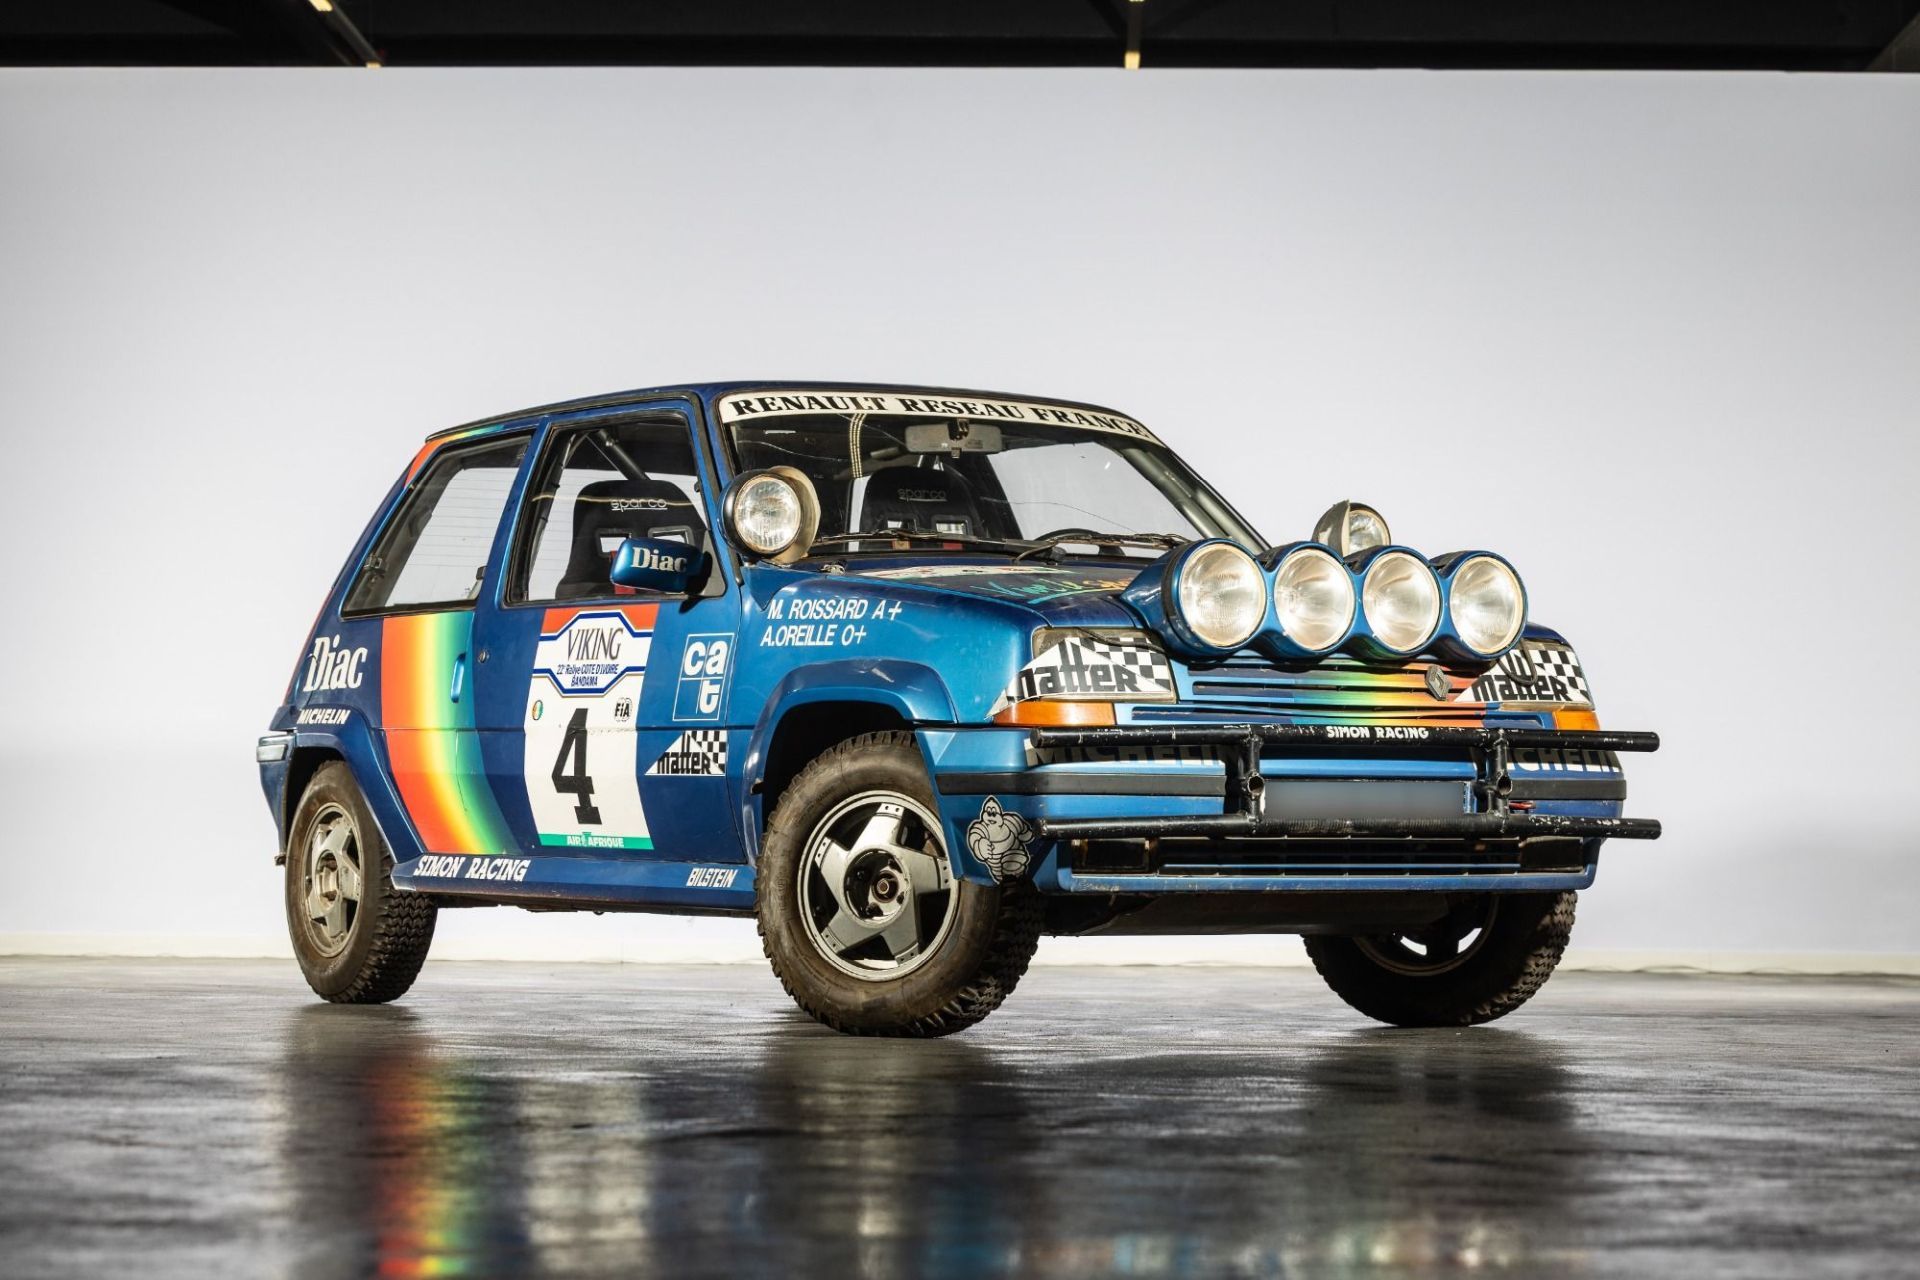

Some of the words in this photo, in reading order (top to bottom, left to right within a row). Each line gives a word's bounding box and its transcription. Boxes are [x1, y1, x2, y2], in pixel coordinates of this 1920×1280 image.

[729, 395, 888, 416] RENAULT
[895, 397, 1024, 419] RESEAU
[1028, 406, 1151, 439] FRANCE
[610, 498, 668, 513] sparco
[630, 546, 688, 573] Diac
[767, 599, 783, 620] M.
[788, 599, 869, 620] ROISSARD
[871, 600, 902, 621] A+
[567, 627, 624, 661] VIKING
[759, 624, 838, 647] A.OREILLE
[302, 633, 368, 692] Diac
[296, 708, 351, 725] MICHELIN
[1325, 726, 1370, 738] SIMON
[1374, 727, 1429, 739] RACING
[551, 707, 603, 826] 4
[588, 836, 625, 848] AFRIQUE
[413, 855, 462, 878] SIMON
[464, 857, 531, 881] RACING
[685, 867, 738, 888] BILSTEIN
